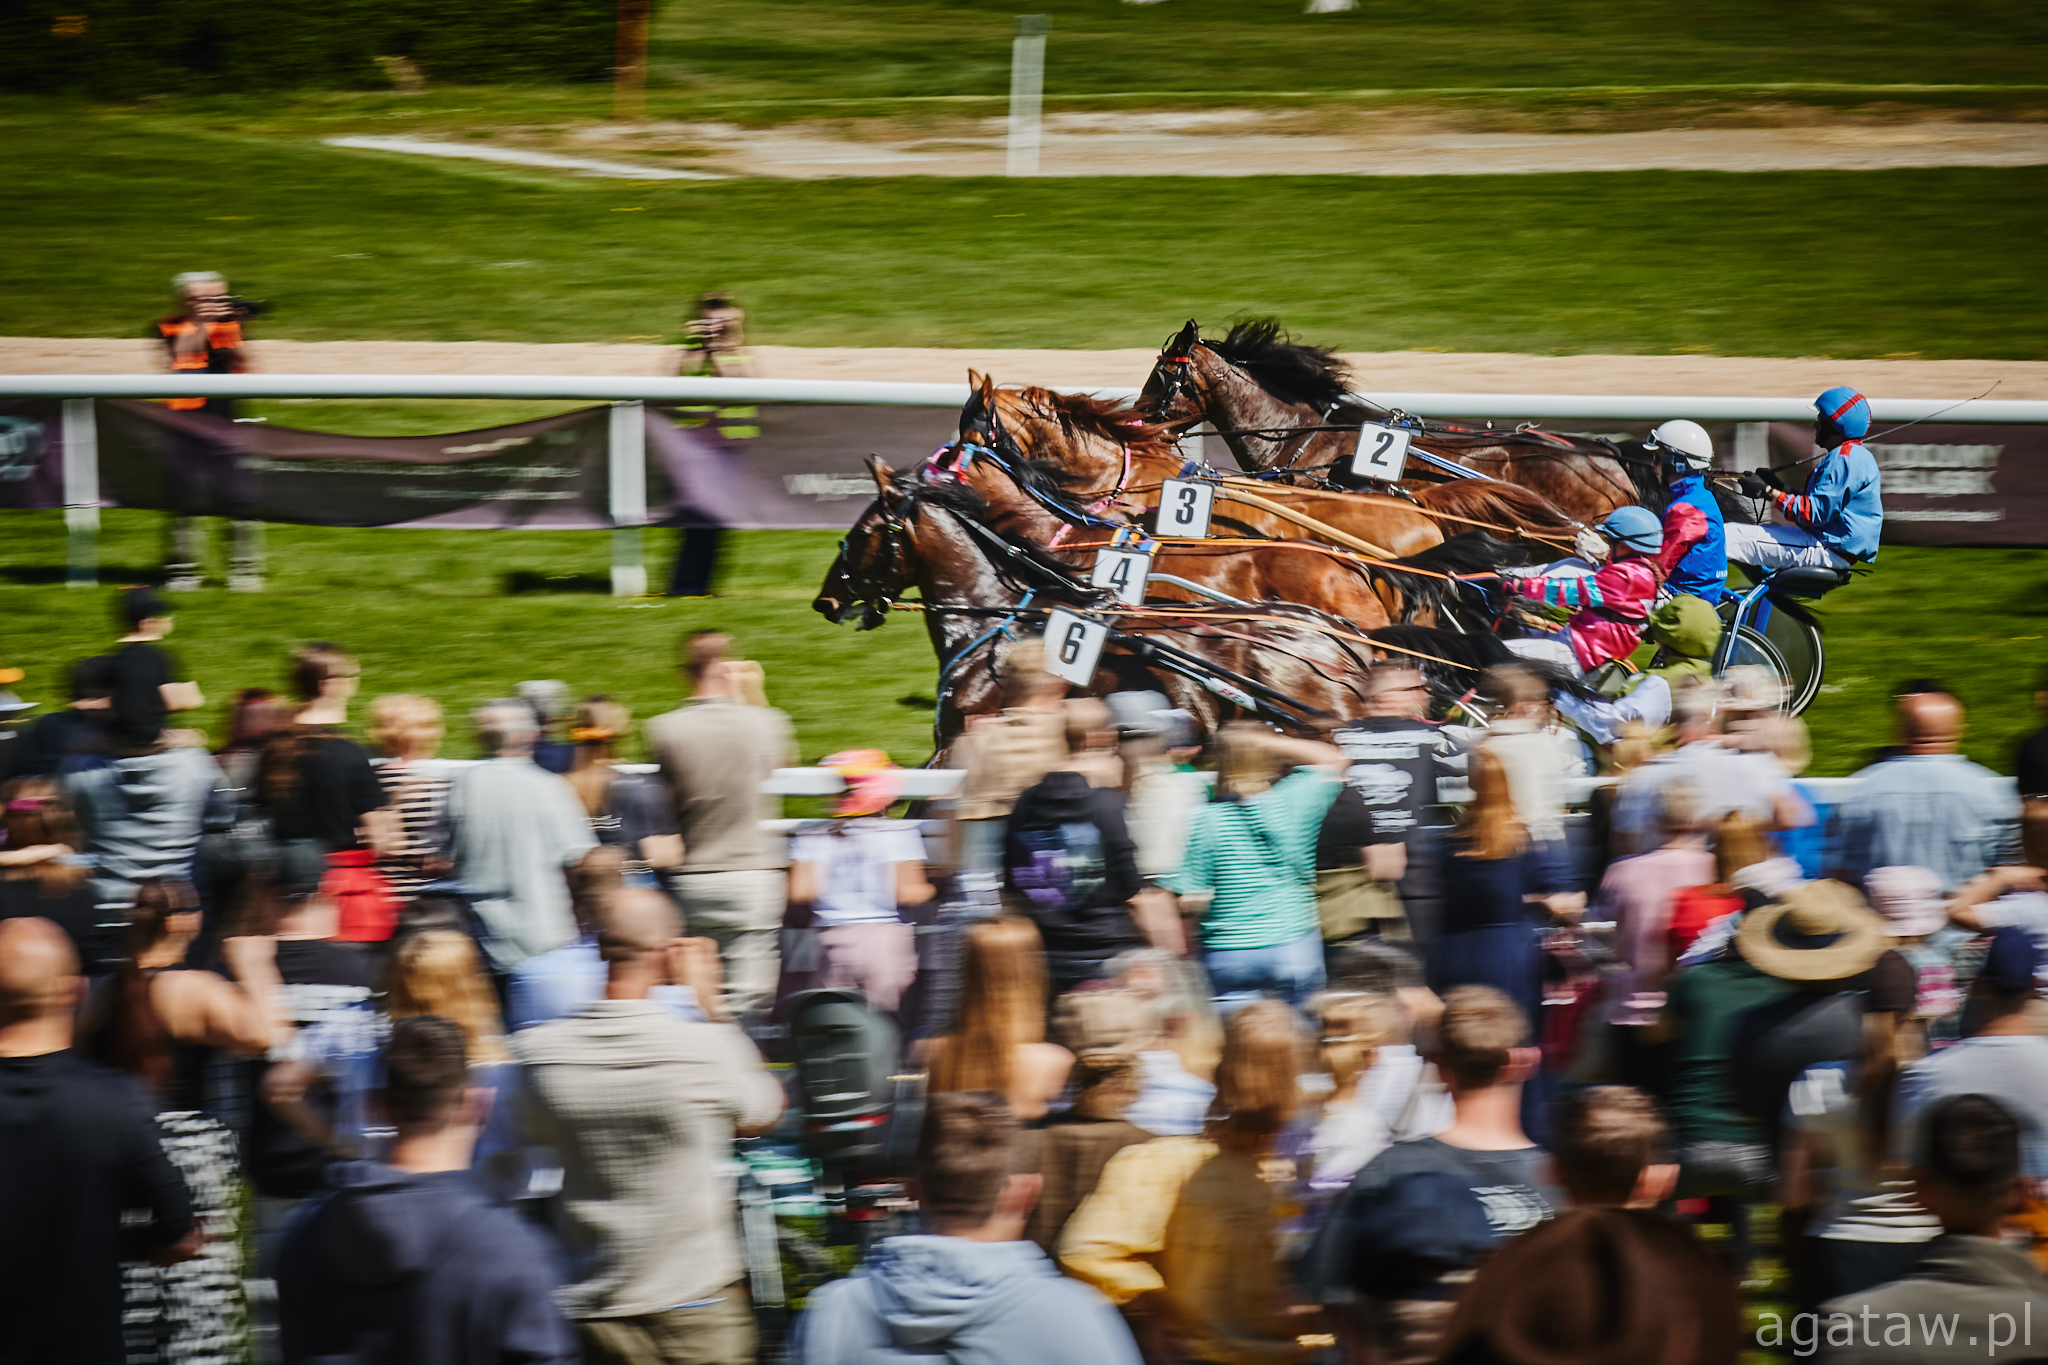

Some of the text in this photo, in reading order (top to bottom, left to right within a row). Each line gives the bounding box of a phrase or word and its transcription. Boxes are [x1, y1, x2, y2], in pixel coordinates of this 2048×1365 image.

[1370, 432, 1395, 467] 2
[1175, 487, 1198, 525] 3
[1109, 557, 1131, 594] 4
[1060, 621, 1086, 665] 6
